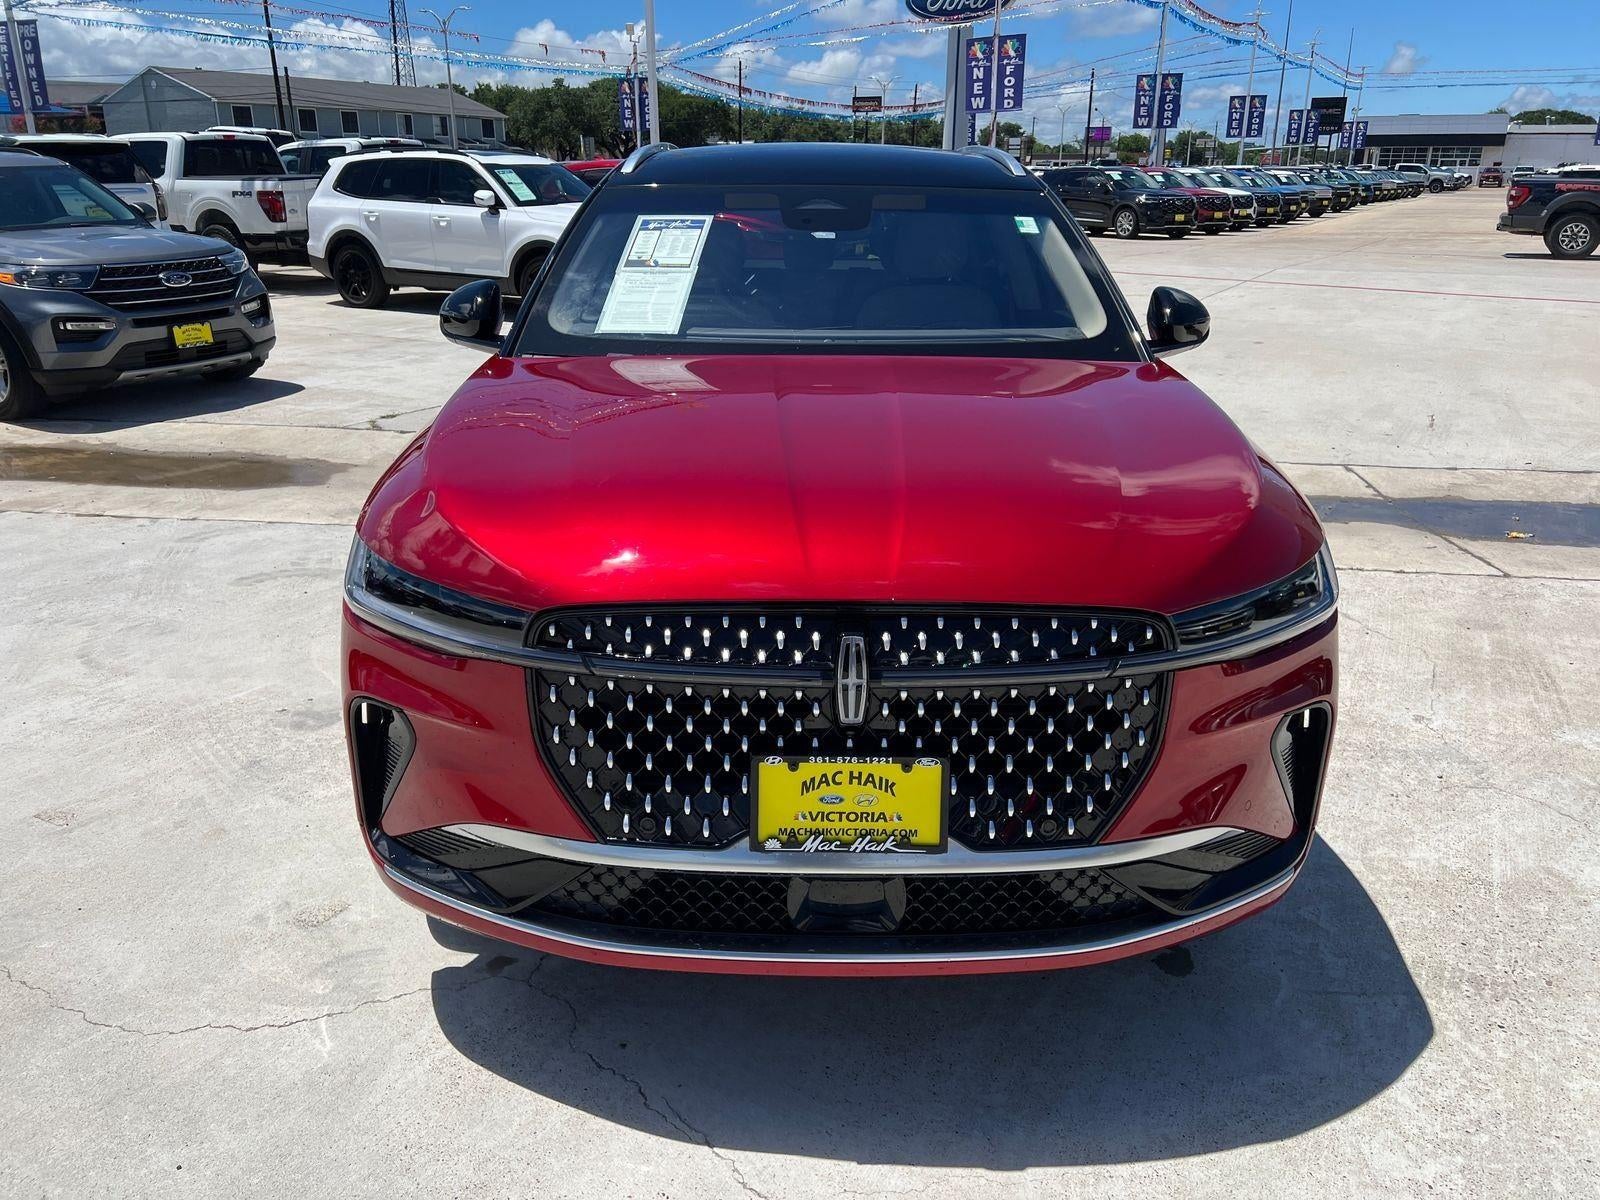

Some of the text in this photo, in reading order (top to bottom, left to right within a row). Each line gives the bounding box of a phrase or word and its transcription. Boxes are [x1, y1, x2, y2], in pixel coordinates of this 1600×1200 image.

[18, 24, 36, 37] PRE
[0, 26, 21, 107] CERTIFIED
[24, 39, 43, 107] OWNED
[970, 67, 985, 109] NEW
[1003, 65, 1015, 109] FORD
[623, 99, 633, 128] NEW
[1137, 96, 1149, 126] NEW
[1162, 95, 1174, 126] FORD
[1229, 113, 1239, 136] NEW
[1250, 112, 1259, 136] FORD
[1289, 123, 1298, 142] NEW
[1306, 122, 1314, 143] FORD
[231, 190, 253, 199] FX4
[808, 756, 893, 764] 361-576-1221
[801, 770, 897, 797] MAC HAIK
[821, 795, 842, 805] Ford
[806, 811, 889, 823] VICTORIA
[777, 827, 918, 838] MACHAIKVICTORIA.COM
[801, 835, 900, 852] Mac Haik
